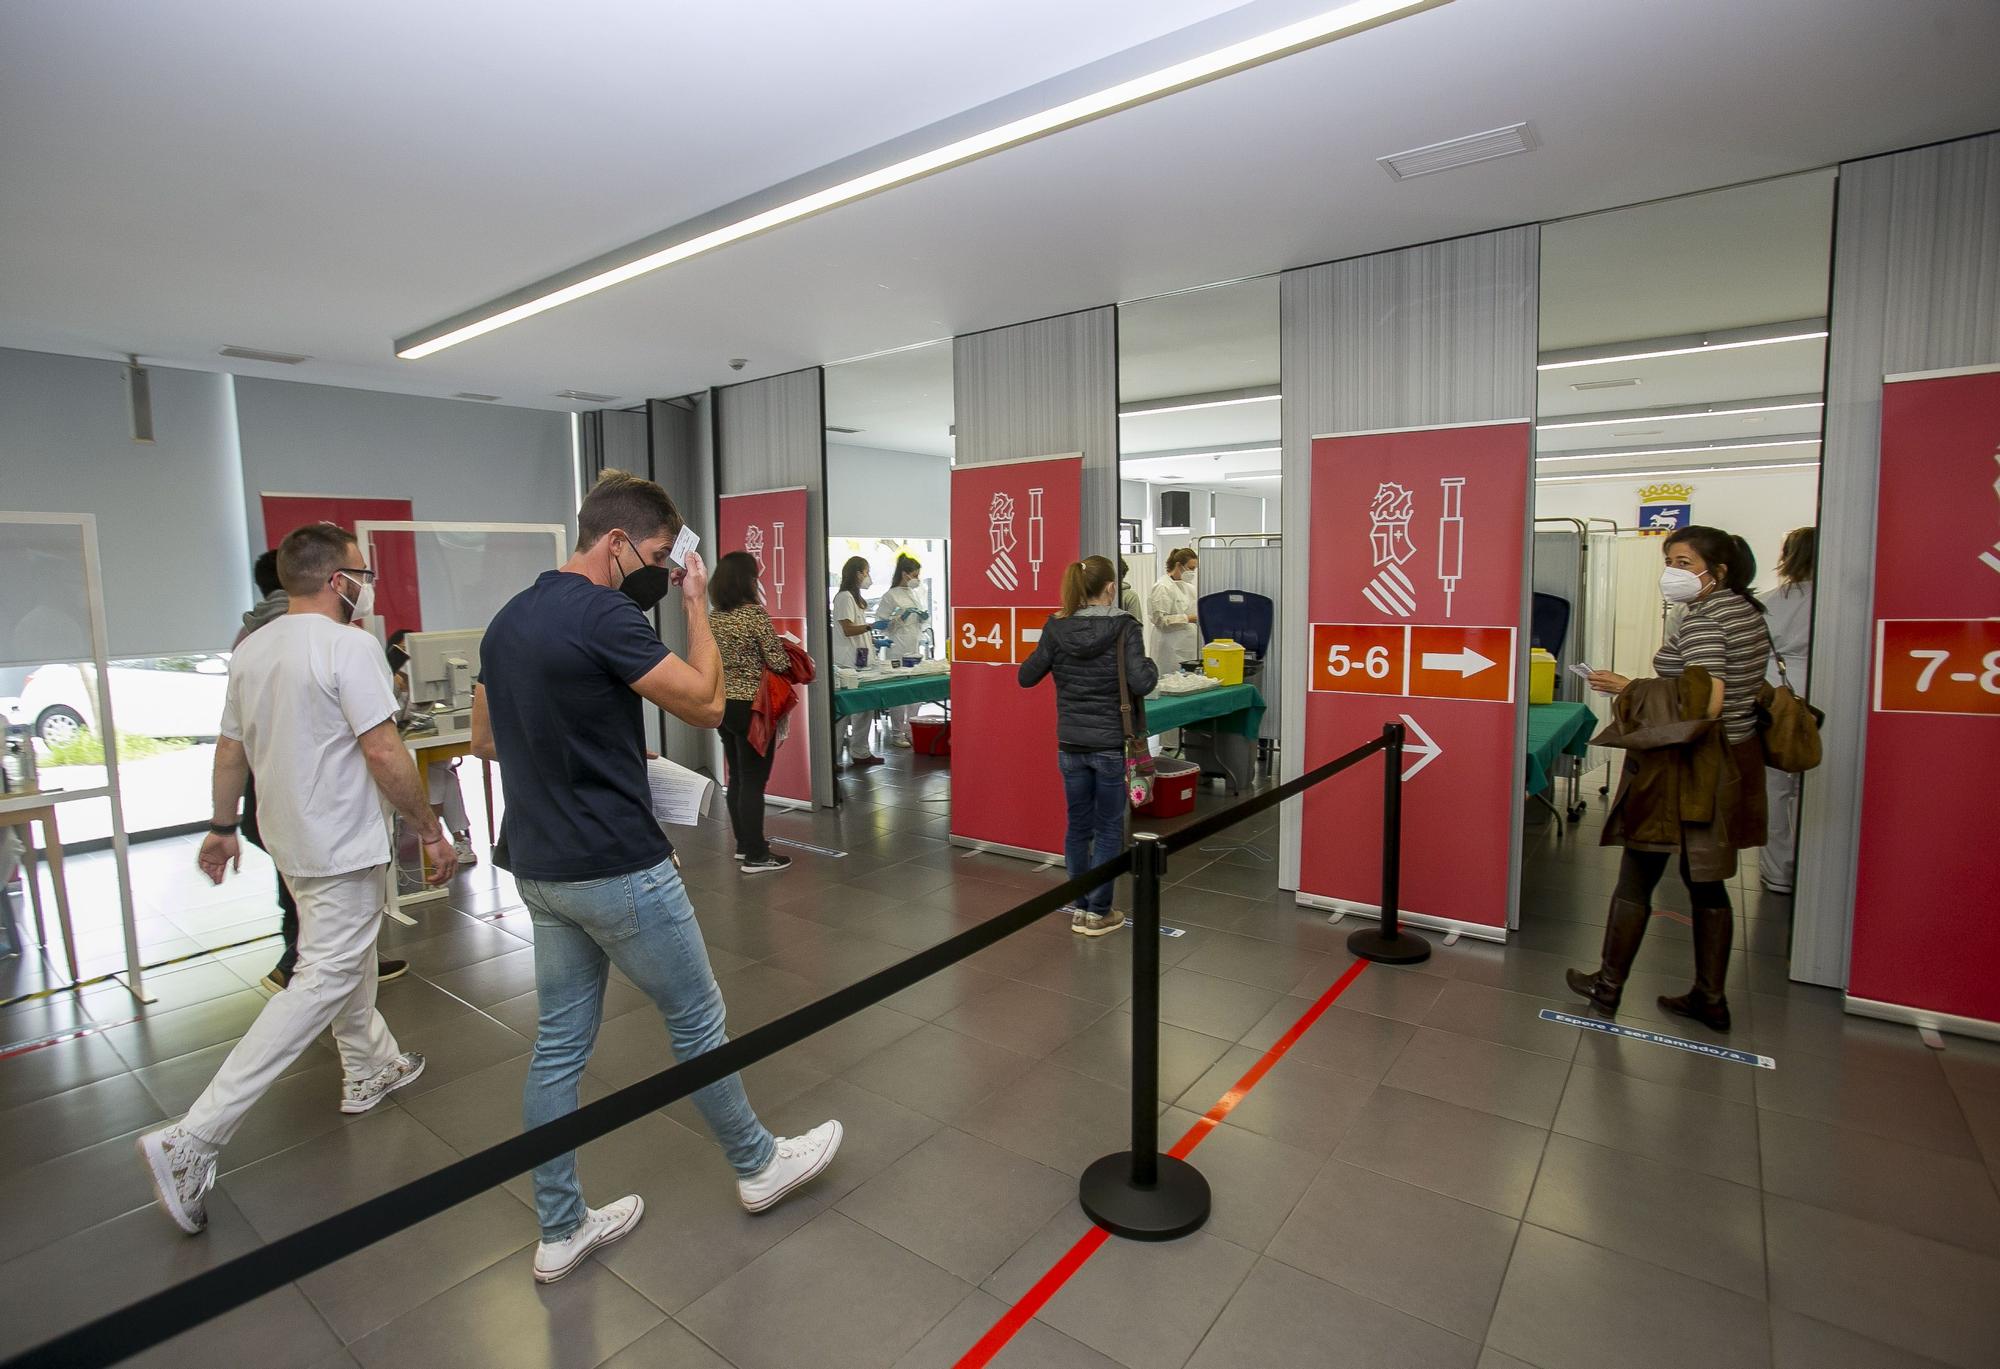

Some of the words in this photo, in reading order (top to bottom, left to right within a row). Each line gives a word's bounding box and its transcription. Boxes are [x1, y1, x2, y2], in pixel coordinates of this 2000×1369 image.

[961, 622, 1004, 650] 3-4
[1327, 644, 1390, 679] 5-6
[1555, 1014, 1606, 1030] Espere
[1623, 1030, 1650, 1040] ser
